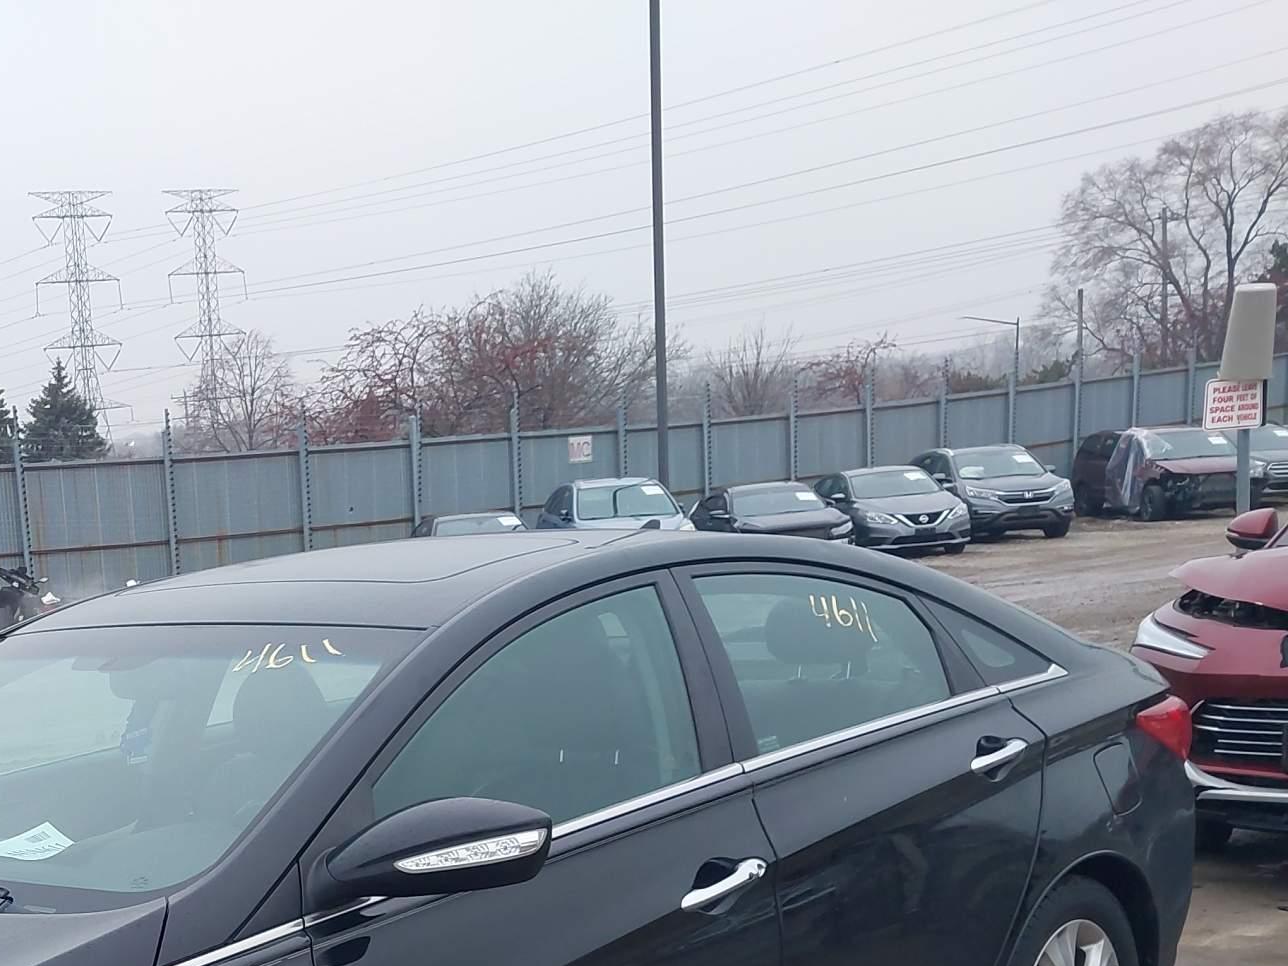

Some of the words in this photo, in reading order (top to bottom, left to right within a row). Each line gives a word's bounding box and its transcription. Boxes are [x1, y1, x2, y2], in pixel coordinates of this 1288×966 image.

[1213, 384, 1240, 393] PLEASE
[1213, 395, 1233, 404] FOUR
[1209, 405, 1235, 413] SPACE
[1211, 415, 1233, 423] EACH
[809, 594, 878, 642] 4611
[232, 639, 346, 673] 4611
